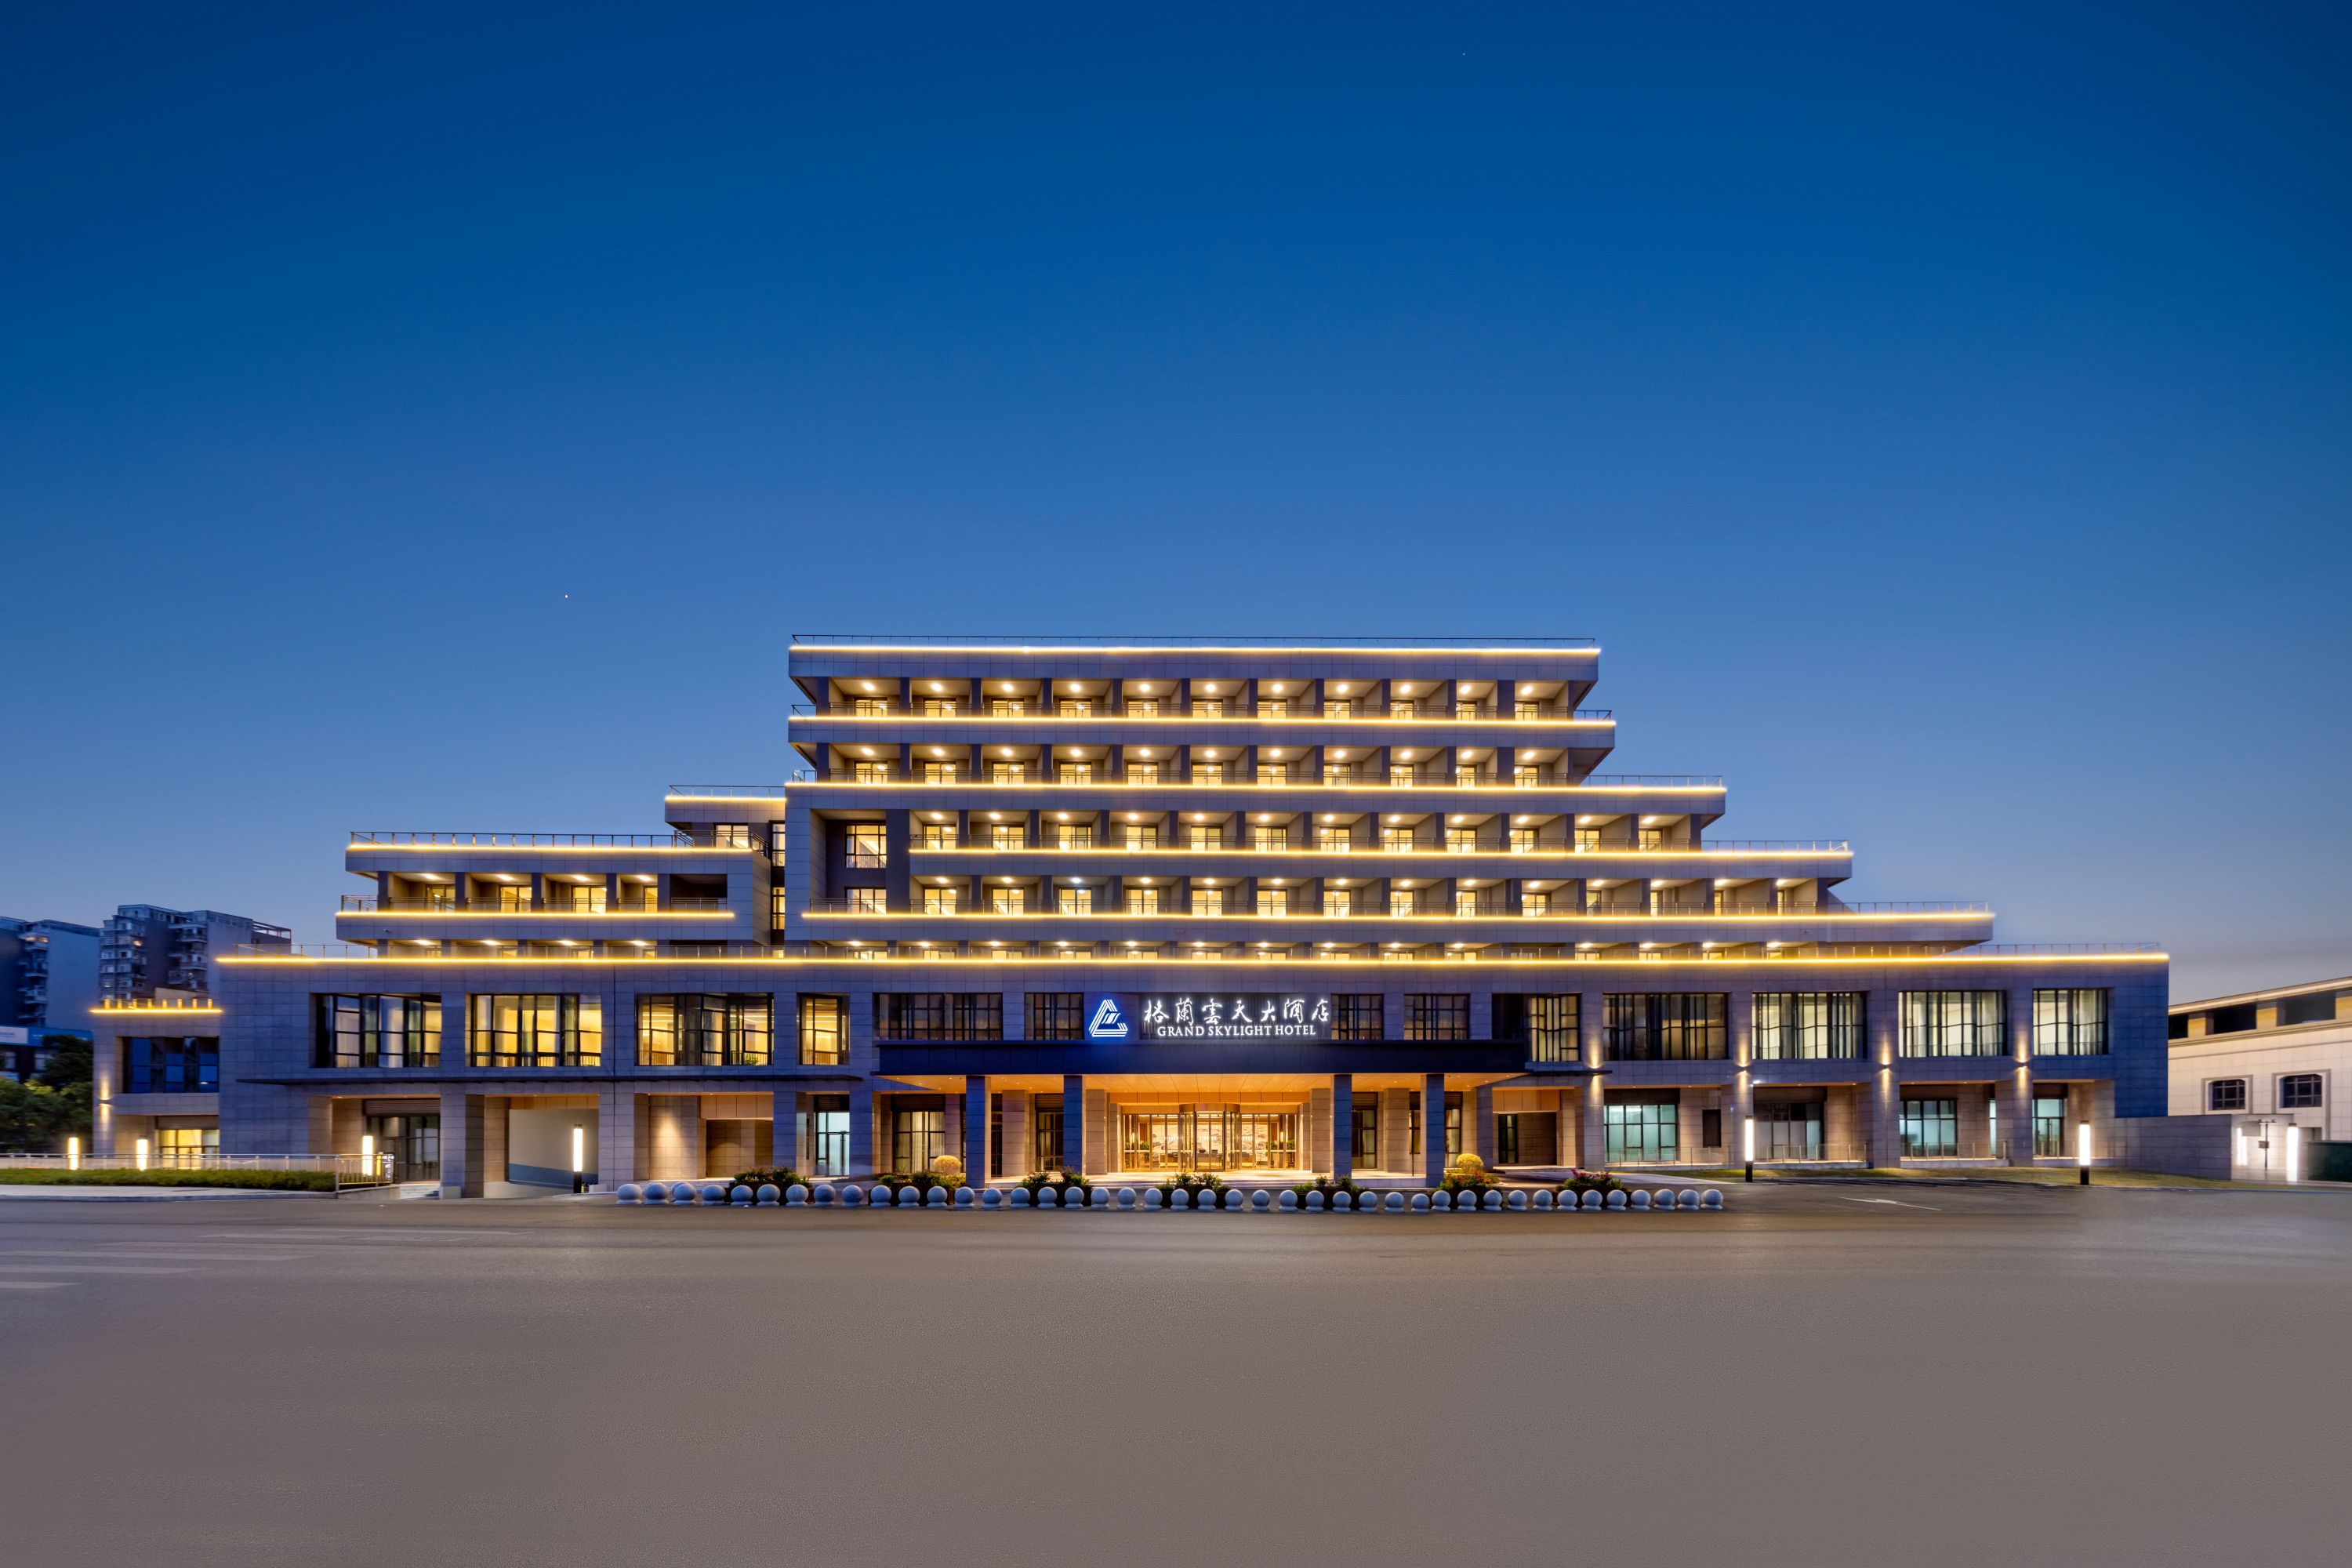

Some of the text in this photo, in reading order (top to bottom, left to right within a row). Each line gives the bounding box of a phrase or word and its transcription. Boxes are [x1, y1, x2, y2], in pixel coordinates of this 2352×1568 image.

[1157, 1025, 1316, 1036] GRAND SKYLIGHT HOTEL
